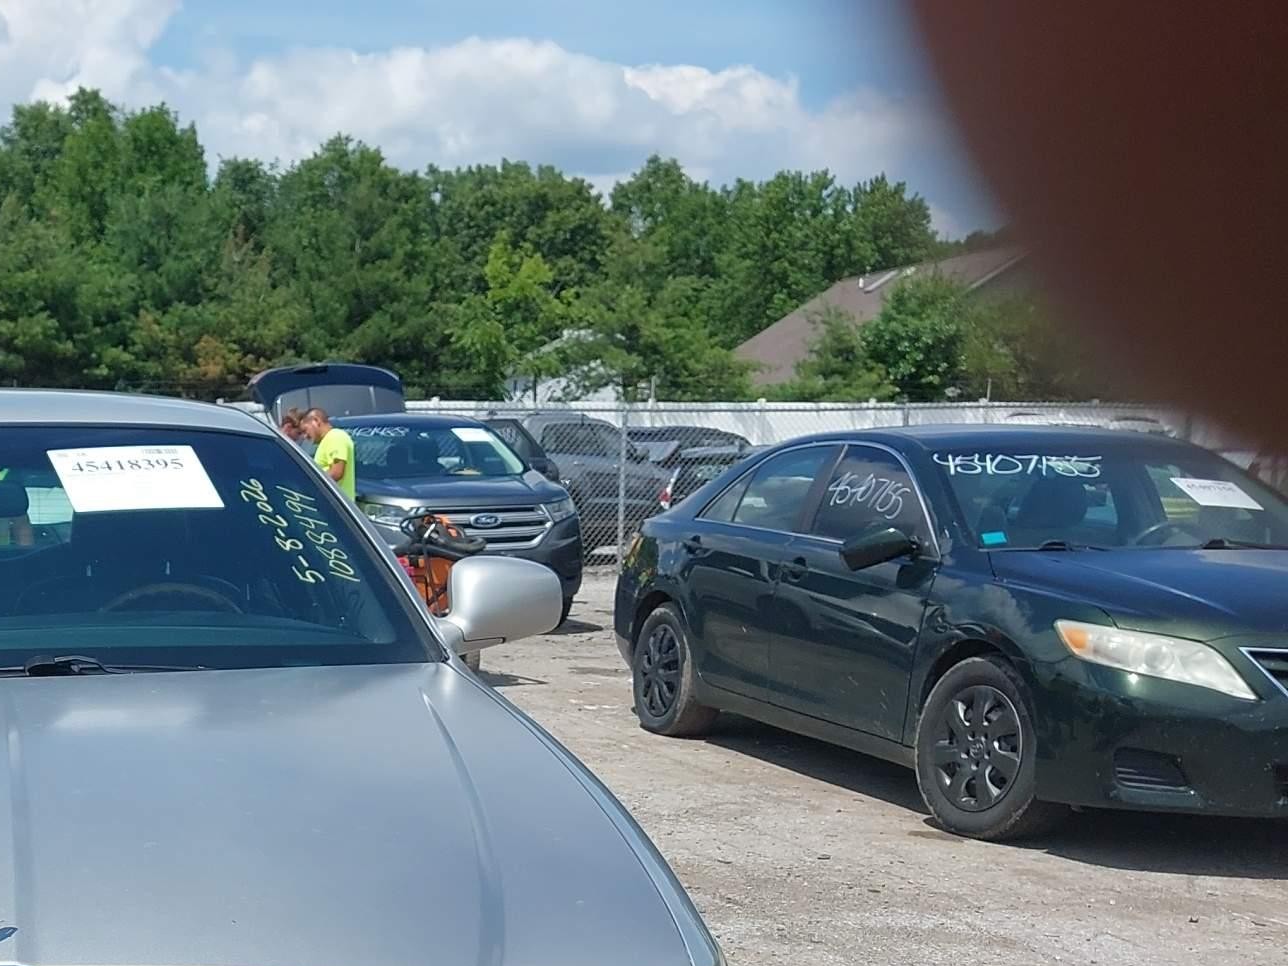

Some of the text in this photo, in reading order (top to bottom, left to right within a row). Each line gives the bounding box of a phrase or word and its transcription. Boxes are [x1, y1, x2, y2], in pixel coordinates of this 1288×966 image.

[71, 458, 185, 473] 45418395
[240, 478, 325, 584] 5-8-2026
[276, 486, 361, 582] 1088494
